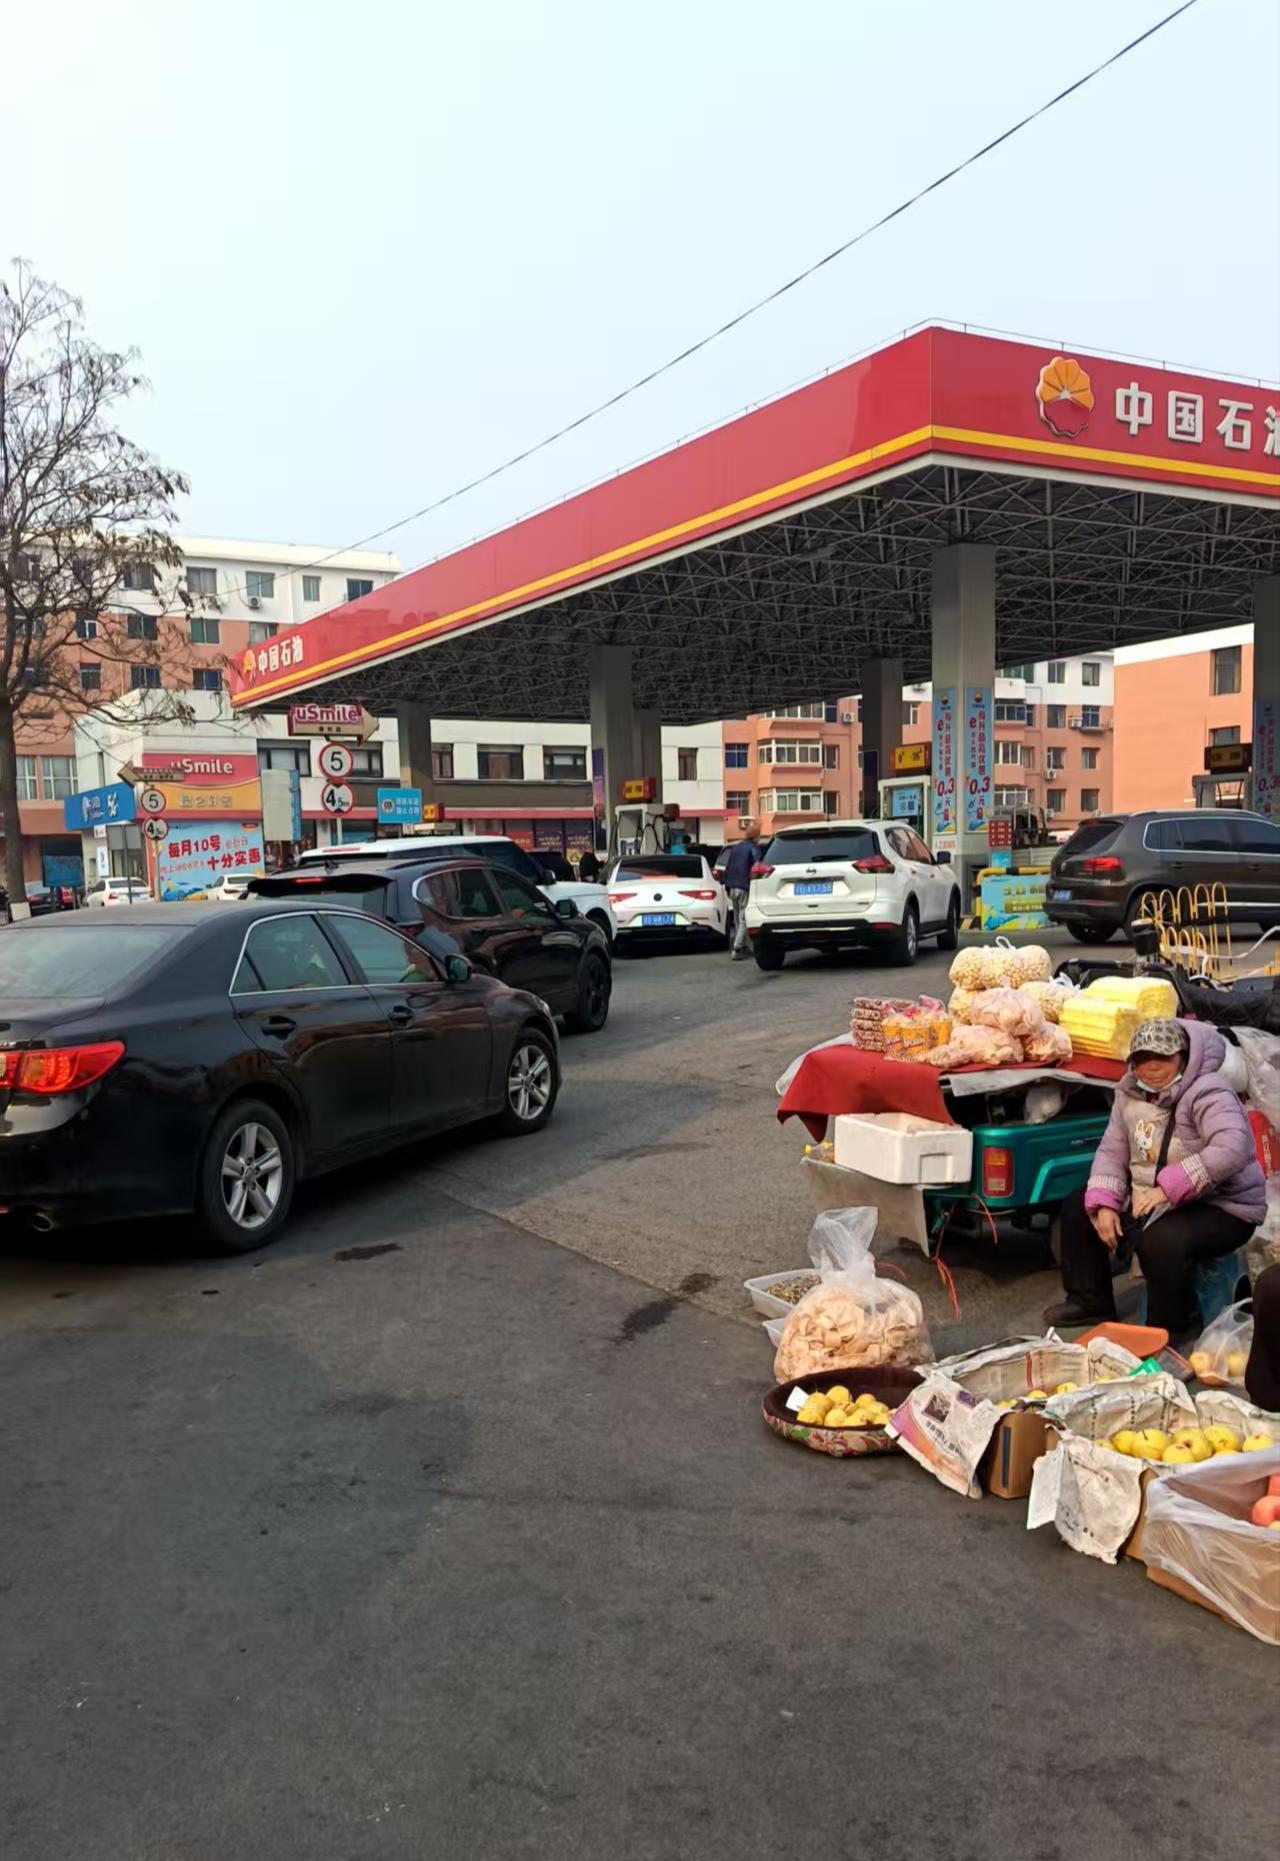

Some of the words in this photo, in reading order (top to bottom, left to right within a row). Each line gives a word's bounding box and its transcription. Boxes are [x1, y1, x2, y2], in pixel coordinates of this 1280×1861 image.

[258, 635, 303, 675] 中国石油
[296, 704, 358, 721] uSmile
[330, 751, 344, 771] 5
[969, 776, 990, 796] 0.3
[148, 794, 159, 809] 5
[168, 834, 221, 858] 每月10号
[207, 847, 261, 871] 十分实惠
